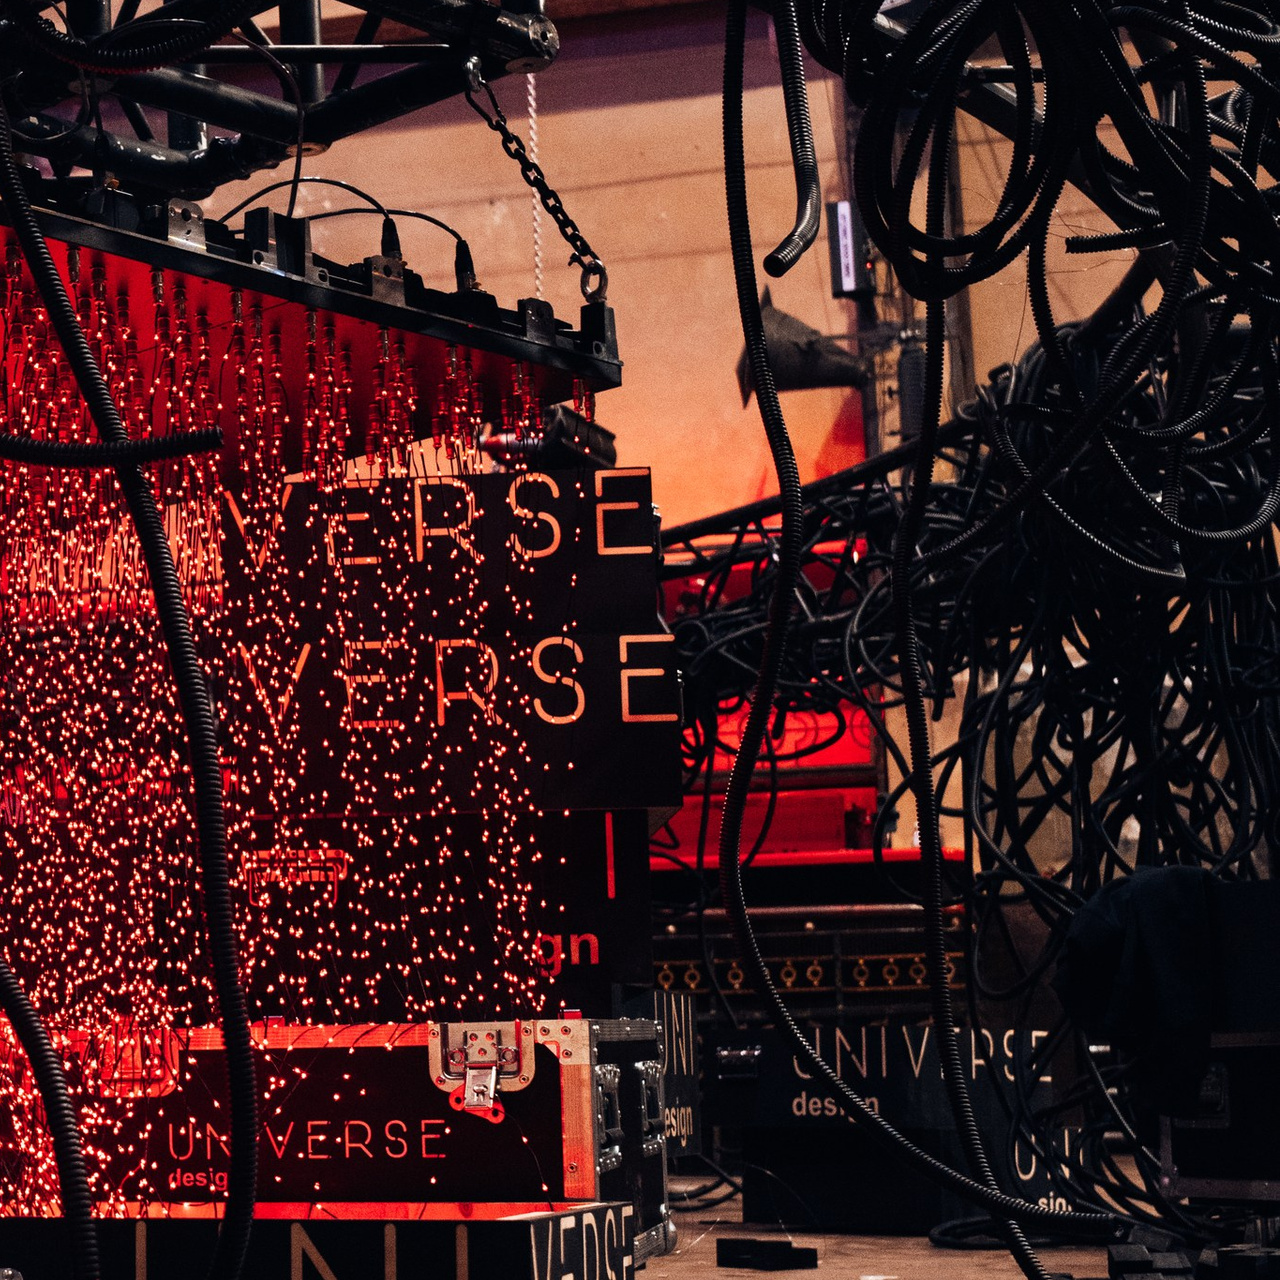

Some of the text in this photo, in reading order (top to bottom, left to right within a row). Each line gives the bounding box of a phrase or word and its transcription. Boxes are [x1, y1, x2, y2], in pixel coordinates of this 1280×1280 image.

[224, 467, 654, 568] VERSE
[239, 634, 679, 728] VERSE
[168, 1120, 447, 1160] UNVERSE
[664, 1097, 693, 1148] esign
[168, 1167, 229, 1191] desig
